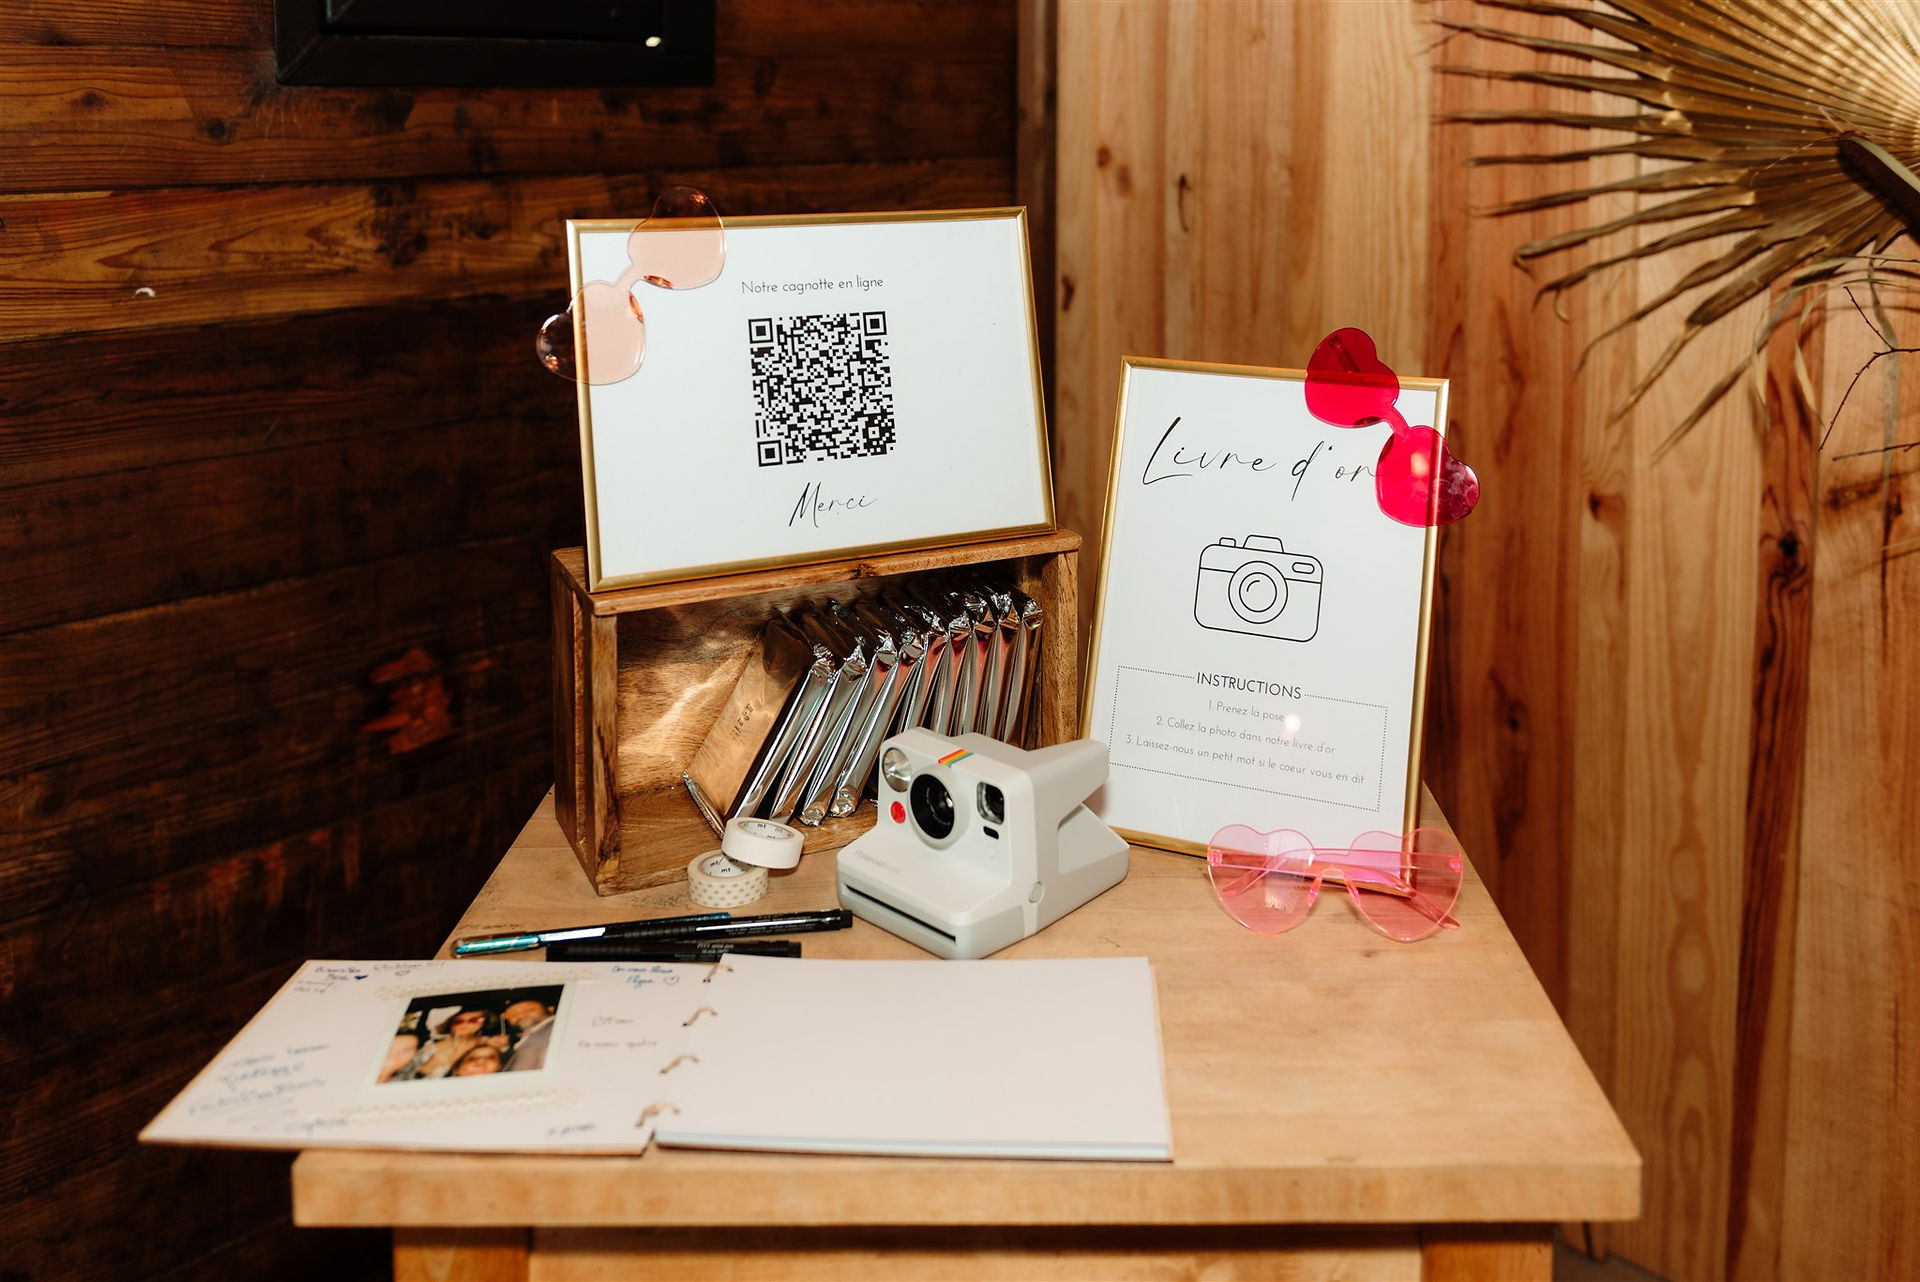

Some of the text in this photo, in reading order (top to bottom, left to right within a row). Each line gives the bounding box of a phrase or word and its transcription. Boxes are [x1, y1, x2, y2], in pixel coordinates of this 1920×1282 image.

[741, 274, 884, 295] Notre cagnotte en ligne
[1142, 416, 1378, 502] Livre d'or
[789, 482, 878, 528] Merci
[1196, 672, 1302, 700] INSTRUCTIONS
[1208, 700, 1285, 723] 1. Prenez la pose
[1156, 715, 1335, 755] 2. Collez la photo dans notre livre d'or
[1125, 734, 1364, 784] 3. Laissez-nous un petit mot si le coeur vous en dit
